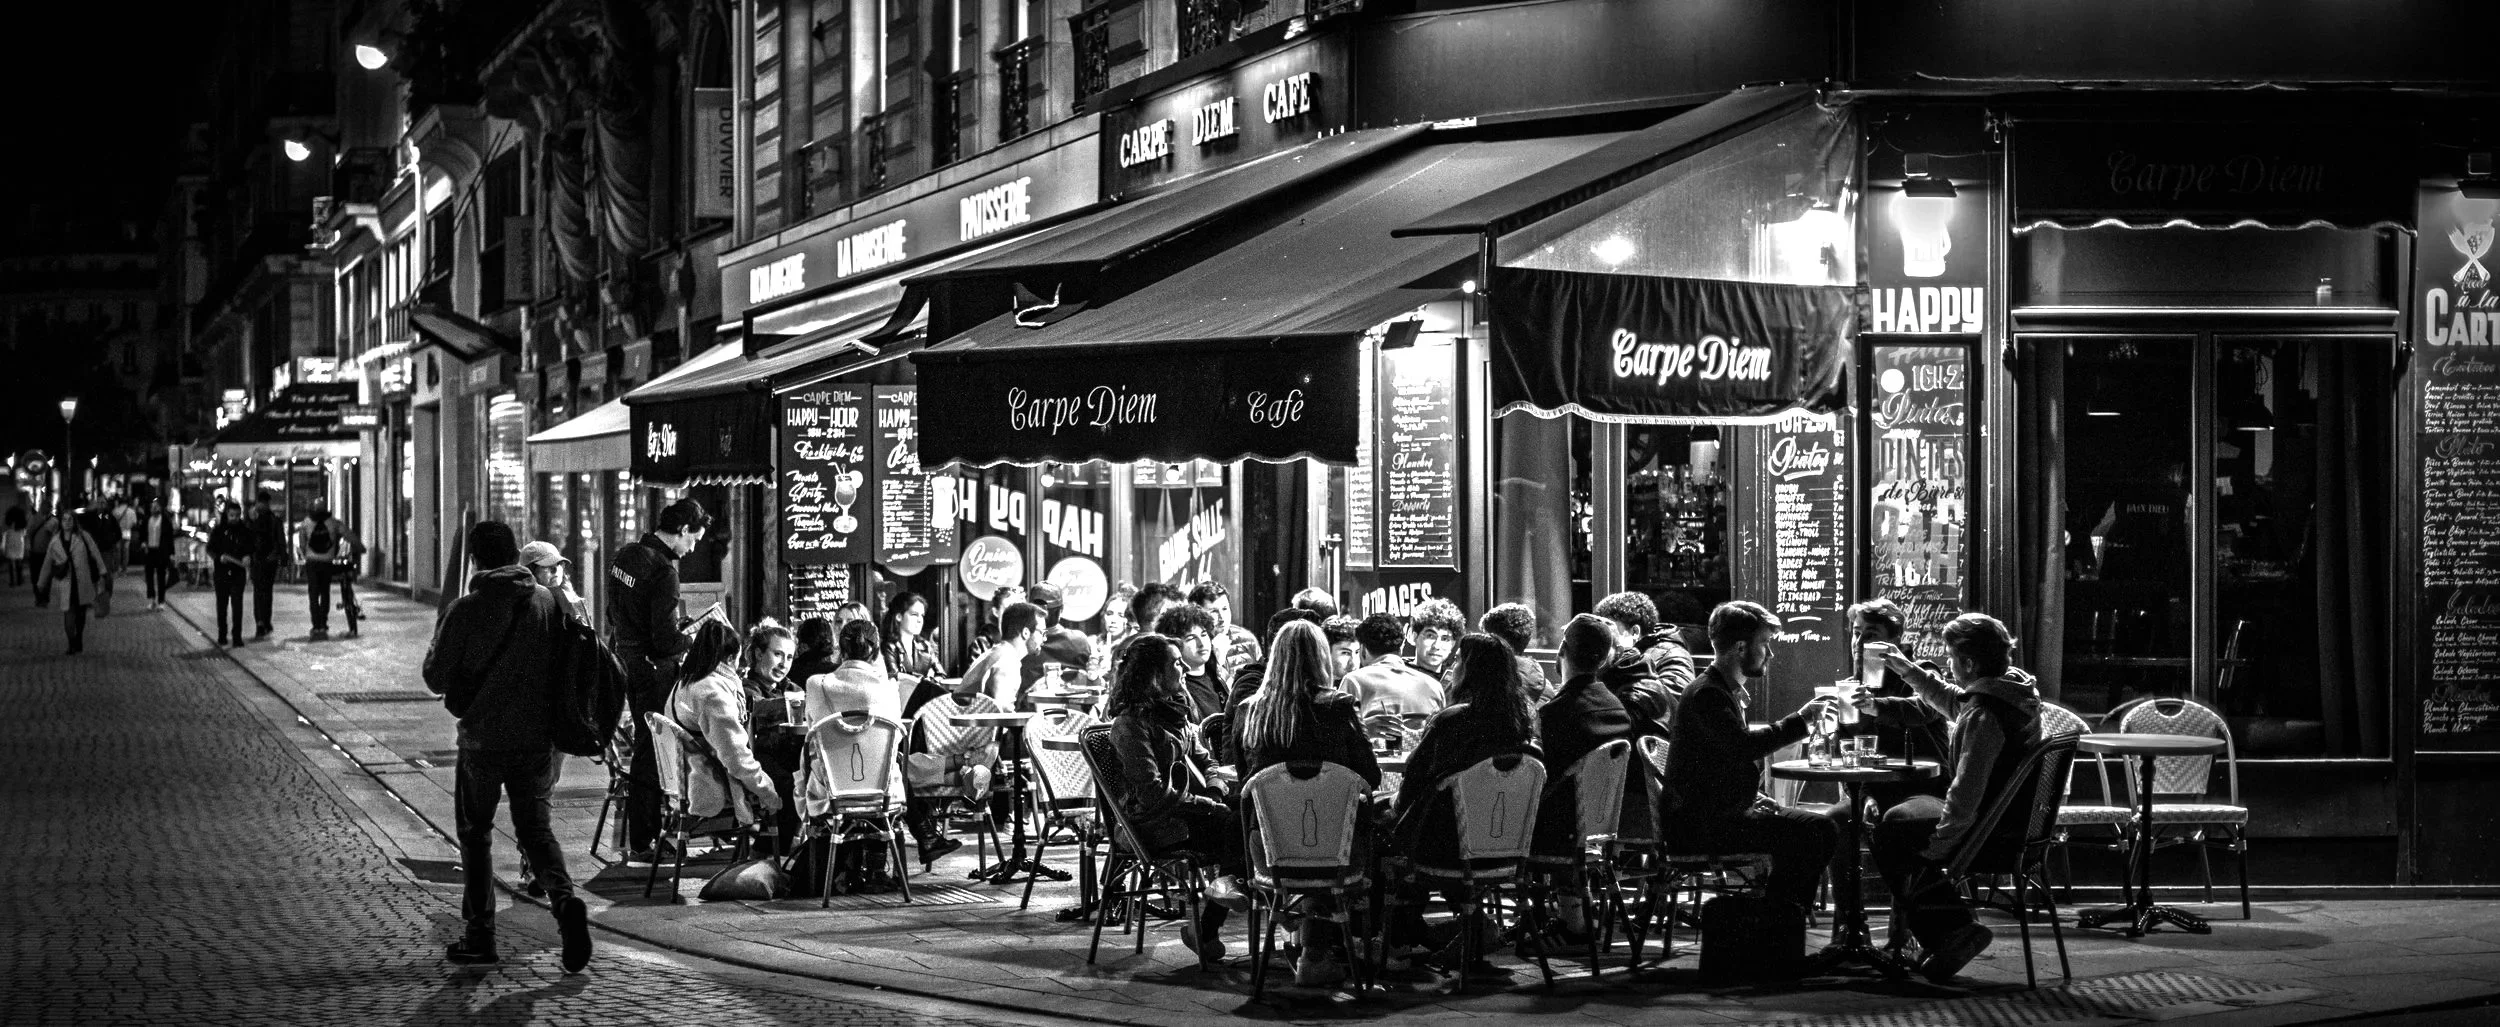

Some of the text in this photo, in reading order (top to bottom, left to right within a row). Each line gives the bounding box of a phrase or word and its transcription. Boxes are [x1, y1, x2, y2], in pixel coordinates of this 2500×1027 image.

[1120, 72, 1311, 168] CARPE DIEM CAFE
[2107, 149, 2326, 201] Carpe Diem
[959, 176, 1031, 242] PATISSERIE
[837, 237, 852, 278] LA
[1872, 287, 1983, 333] HAPPY
[1612, 328, 1771, 386] Carpe Diem
[787, 407, 859, 429] HAPPY HOUR
[803, 390, 852, 406] CARPE DIEM
[878, 408, 911, 428] HAPPY
[1008, 385, 1304, 436] Carpe Diem Café
[2424, 466, 2445, 477] Burger
